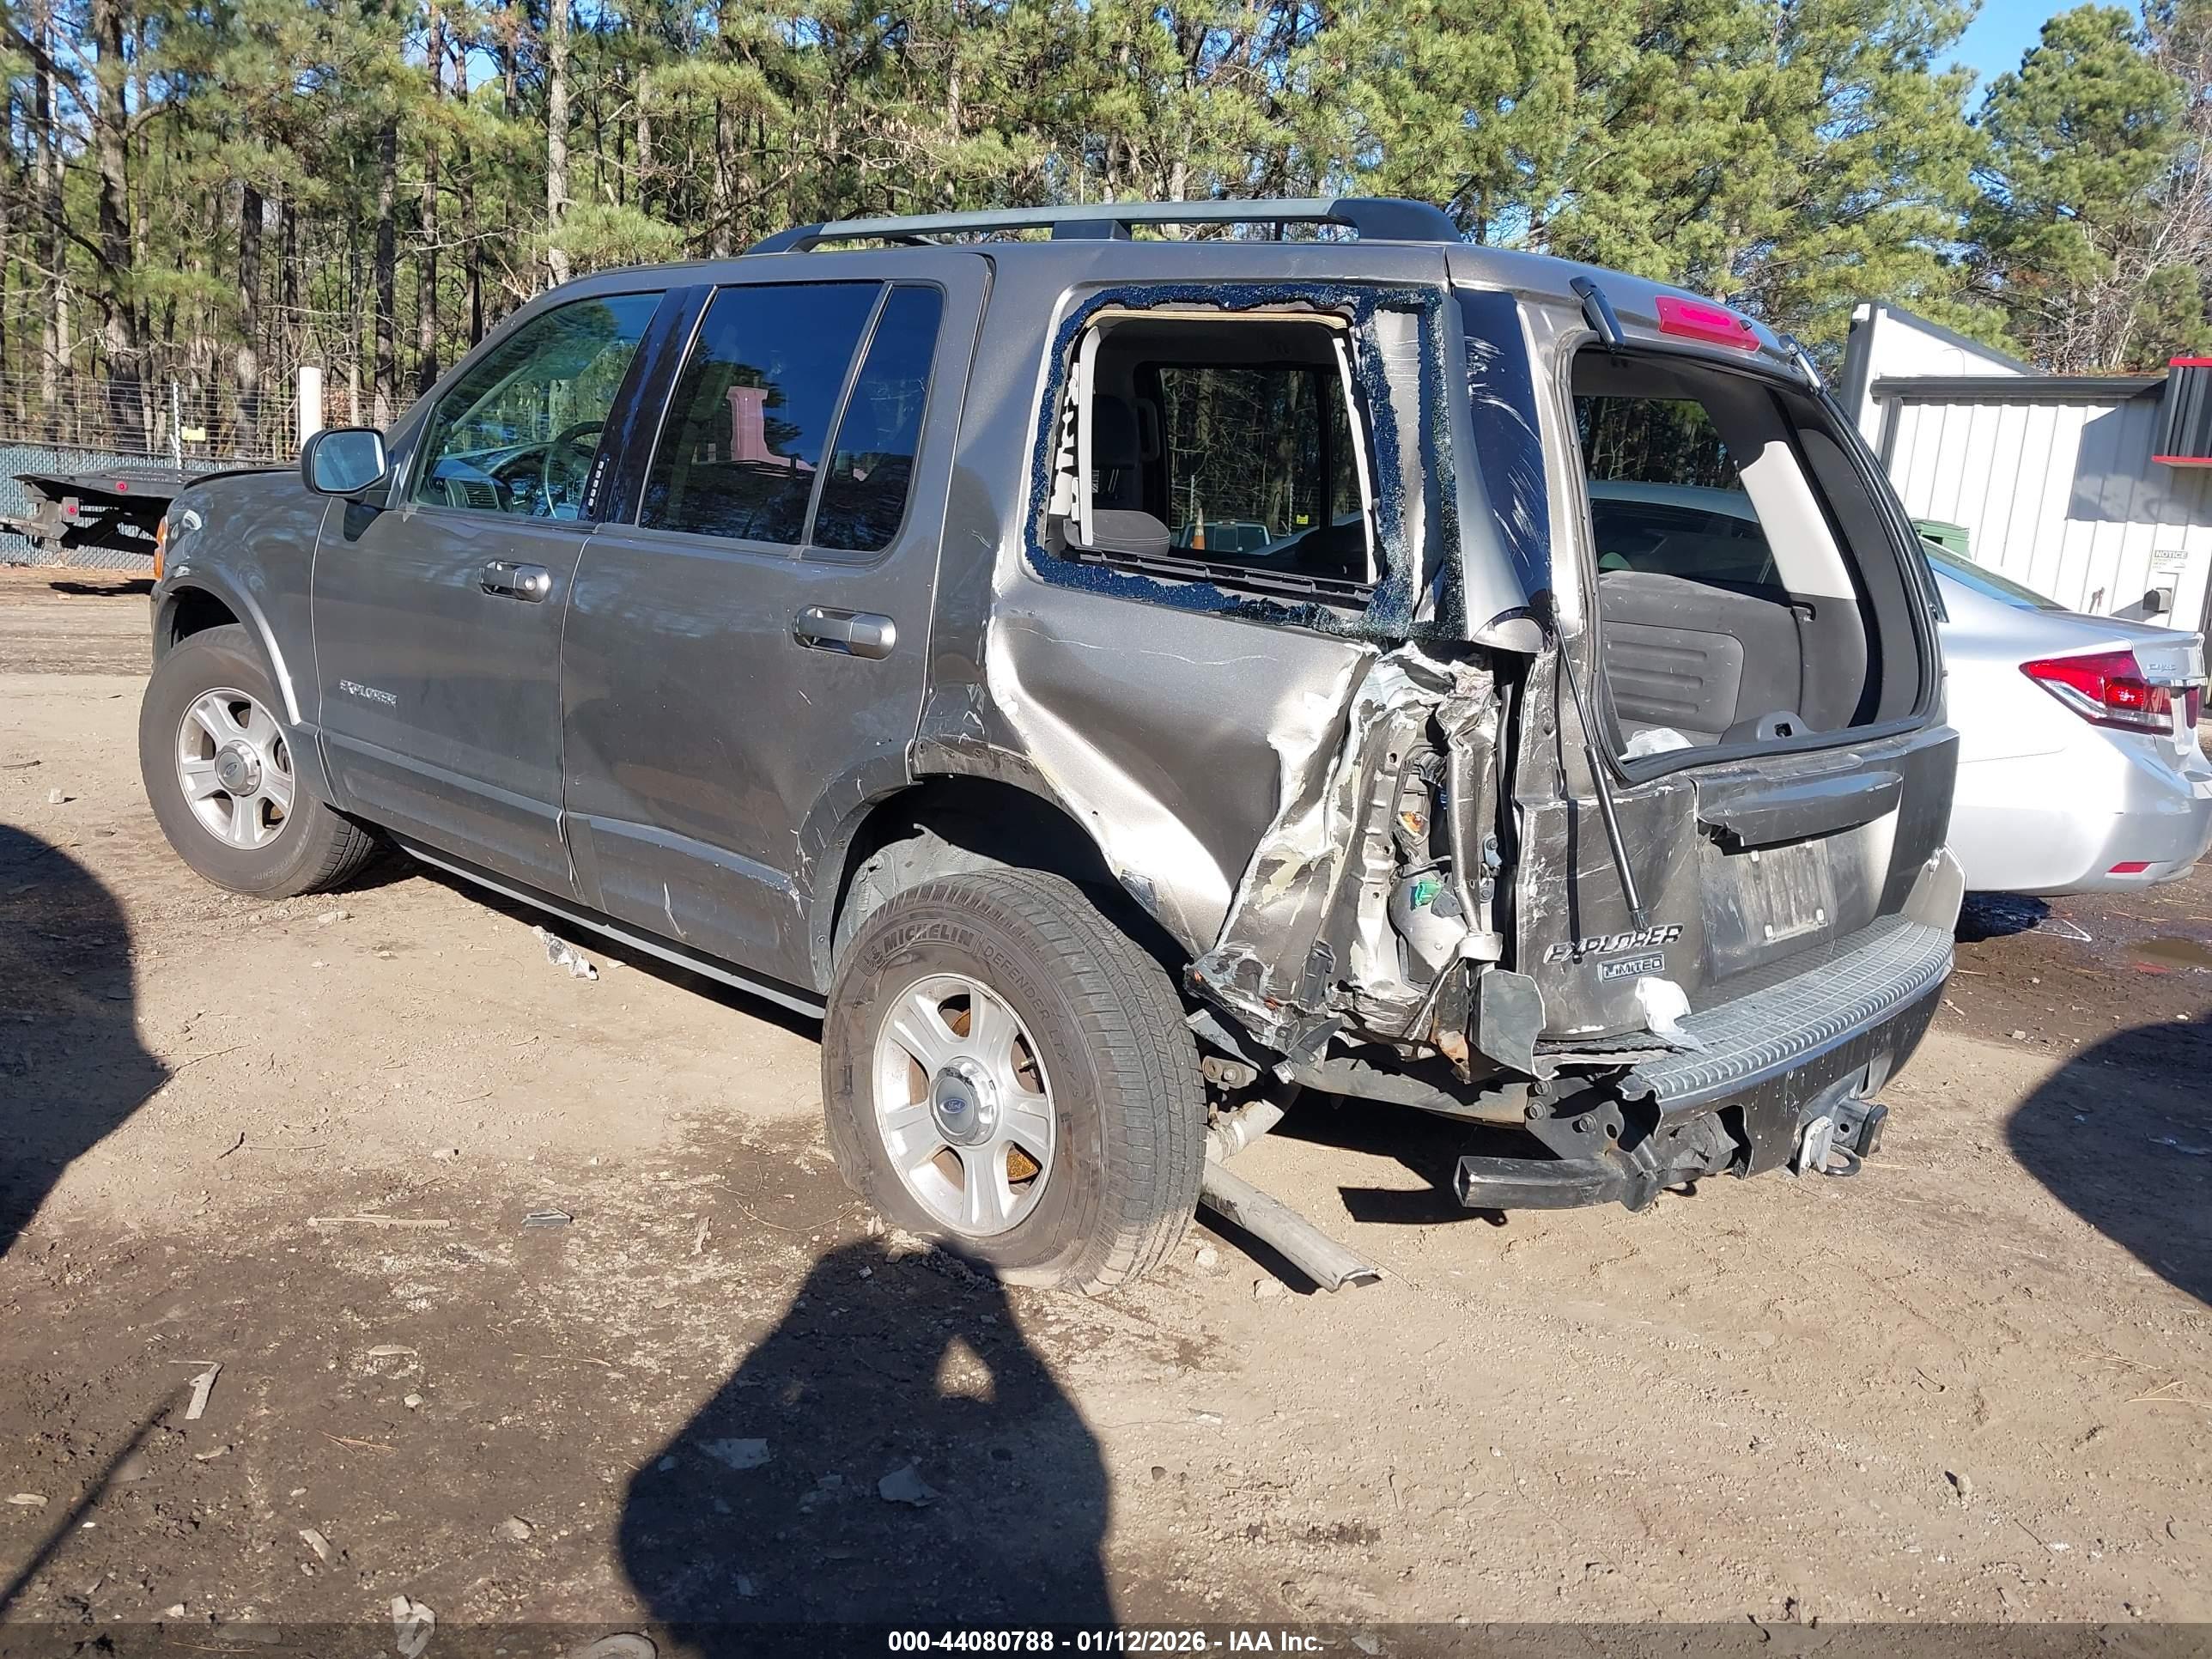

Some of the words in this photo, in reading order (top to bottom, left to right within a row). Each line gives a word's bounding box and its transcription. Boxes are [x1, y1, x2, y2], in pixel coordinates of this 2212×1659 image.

[2154, 550, 2188, 558] NOTICE
[1543, 923, 1684, 964] EXPLORER
[884, 923, 975, 953] MICHELIN
[983, 945, 1052, 1021] DEFENDER
[1604, 956, 1663, 978] LIMITED
